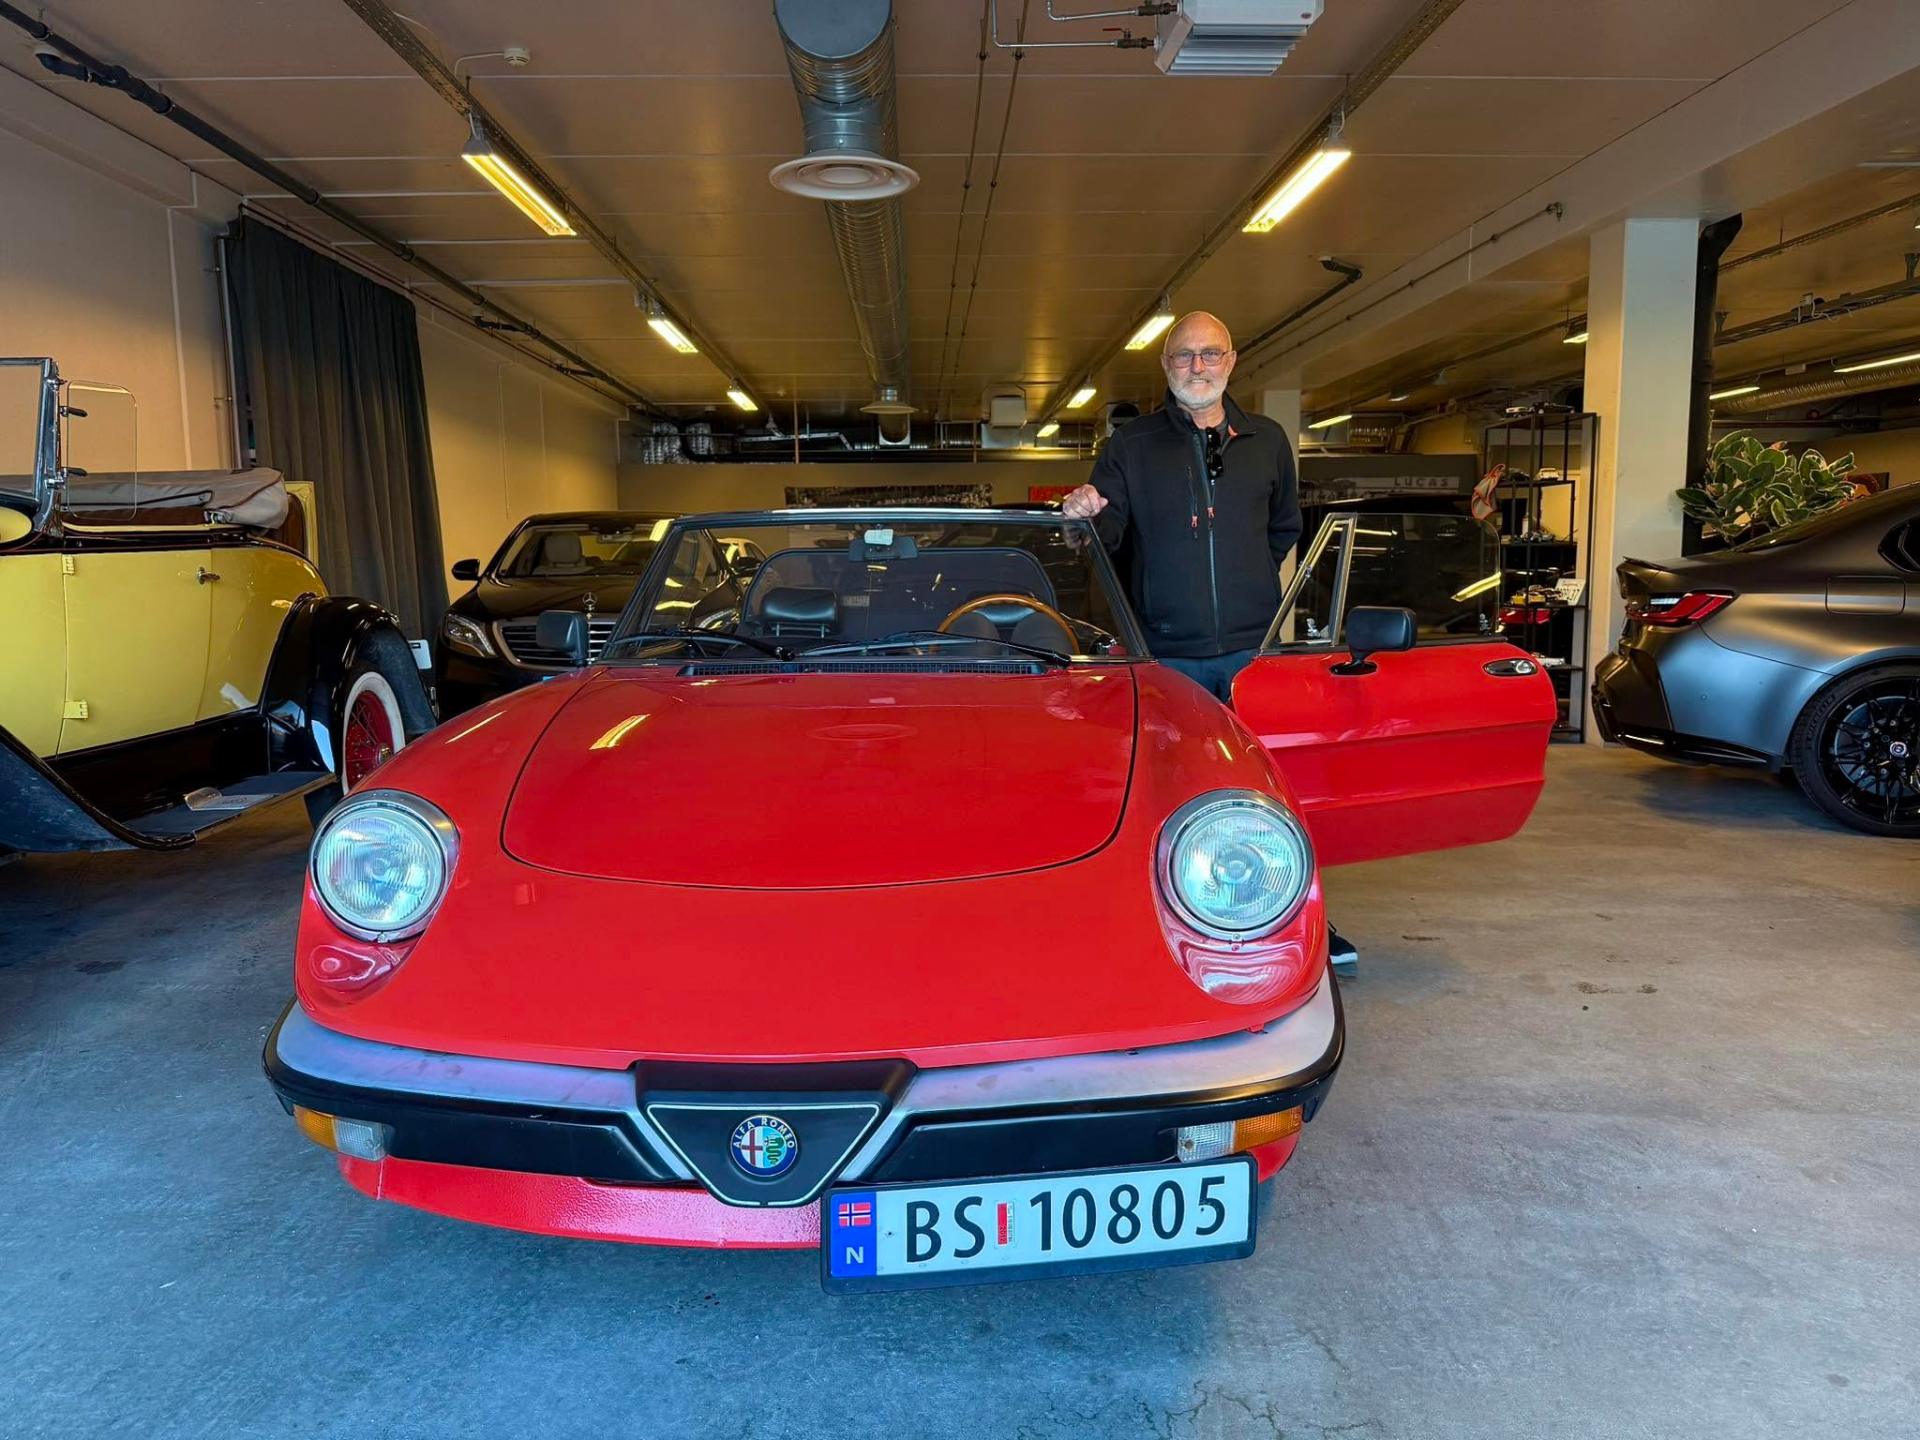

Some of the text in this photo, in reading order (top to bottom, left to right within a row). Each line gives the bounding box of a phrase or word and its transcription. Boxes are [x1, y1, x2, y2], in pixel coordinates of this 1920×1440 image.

[1394, 477, 1449, 487] LUCAS
[733, 1117, 795, 1149] ALFA ROMEO
[906, 1196, 985, 1263] BS
[1030, 1176, 1226, 1252] 10805
[846, 1247, 864, 1265] N
